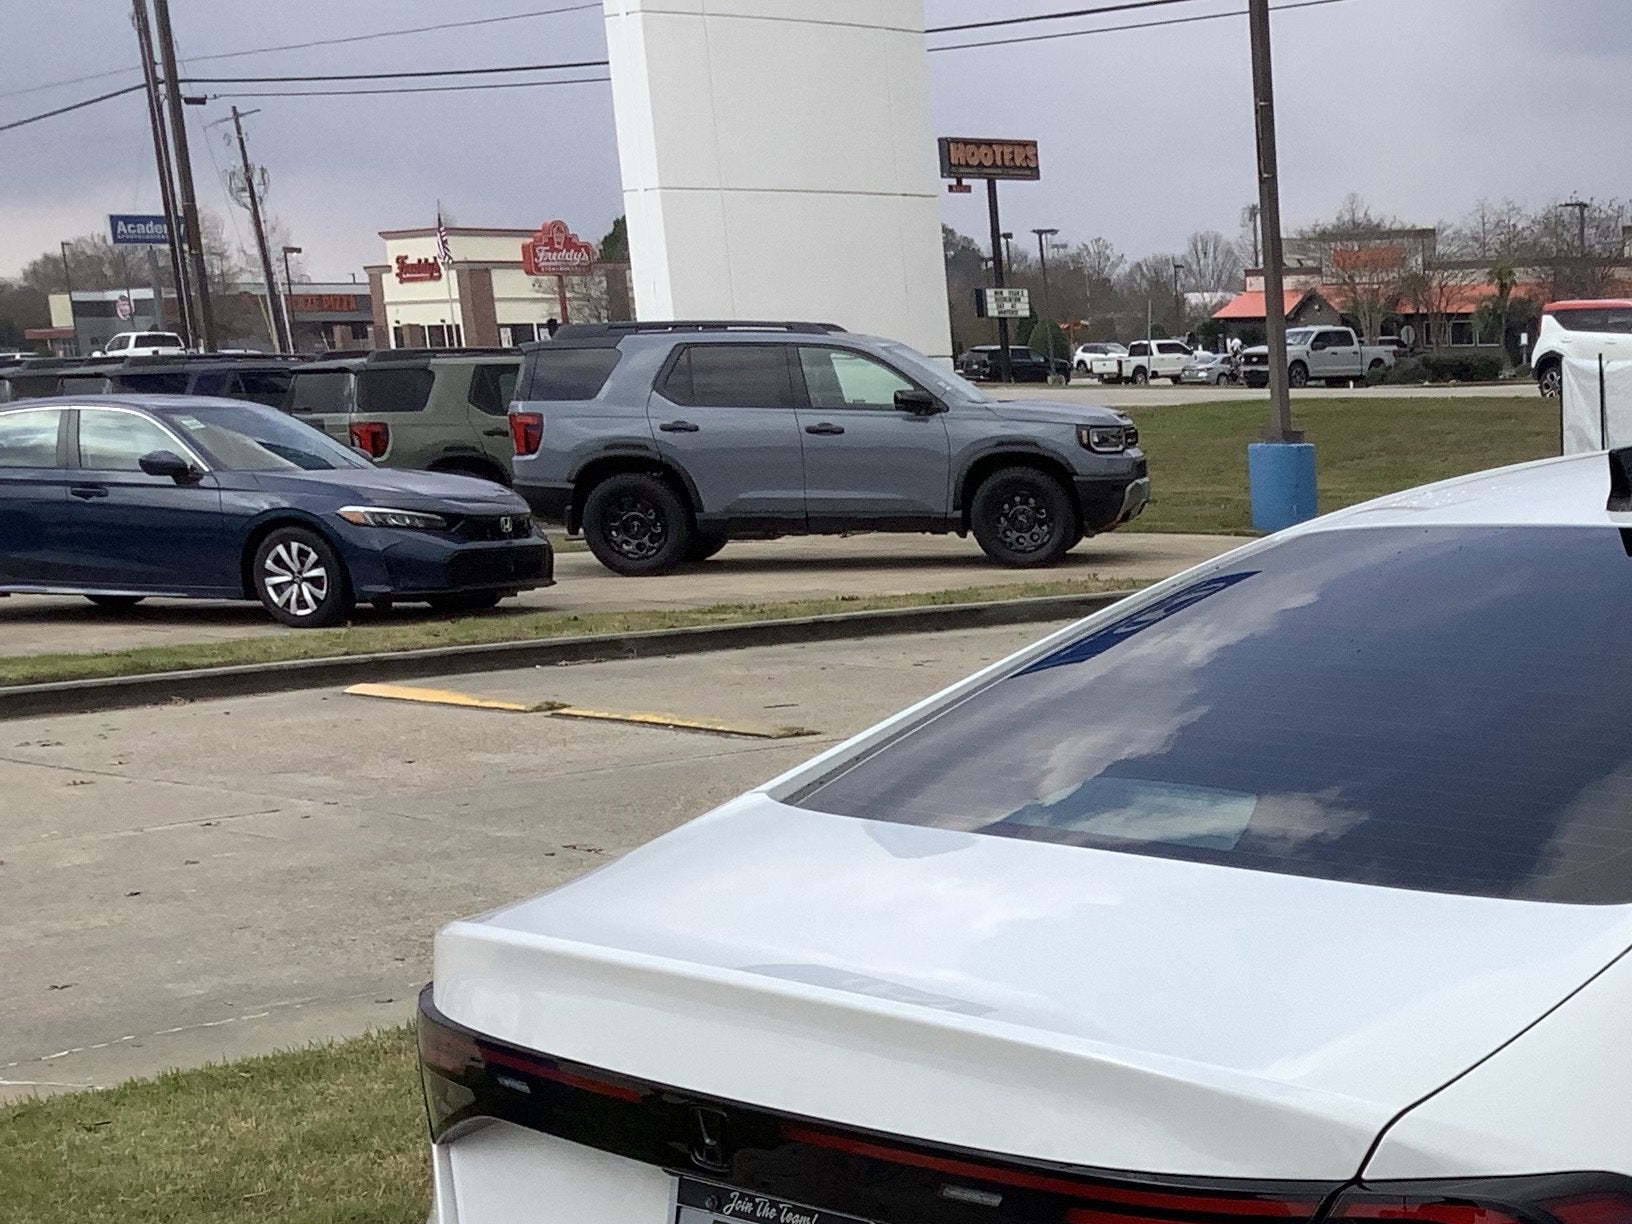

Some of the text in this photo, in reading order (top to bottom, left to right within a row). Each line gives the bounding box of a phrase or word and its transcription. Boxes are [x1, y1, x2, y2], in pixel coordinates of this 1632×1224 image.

[949, 141, 1038, 168] HOOTERS
[535, 246, 589, 266] Freddy's
[723, 1191, 754, 1216] Join
[755, 1197, 778, 1220] The
